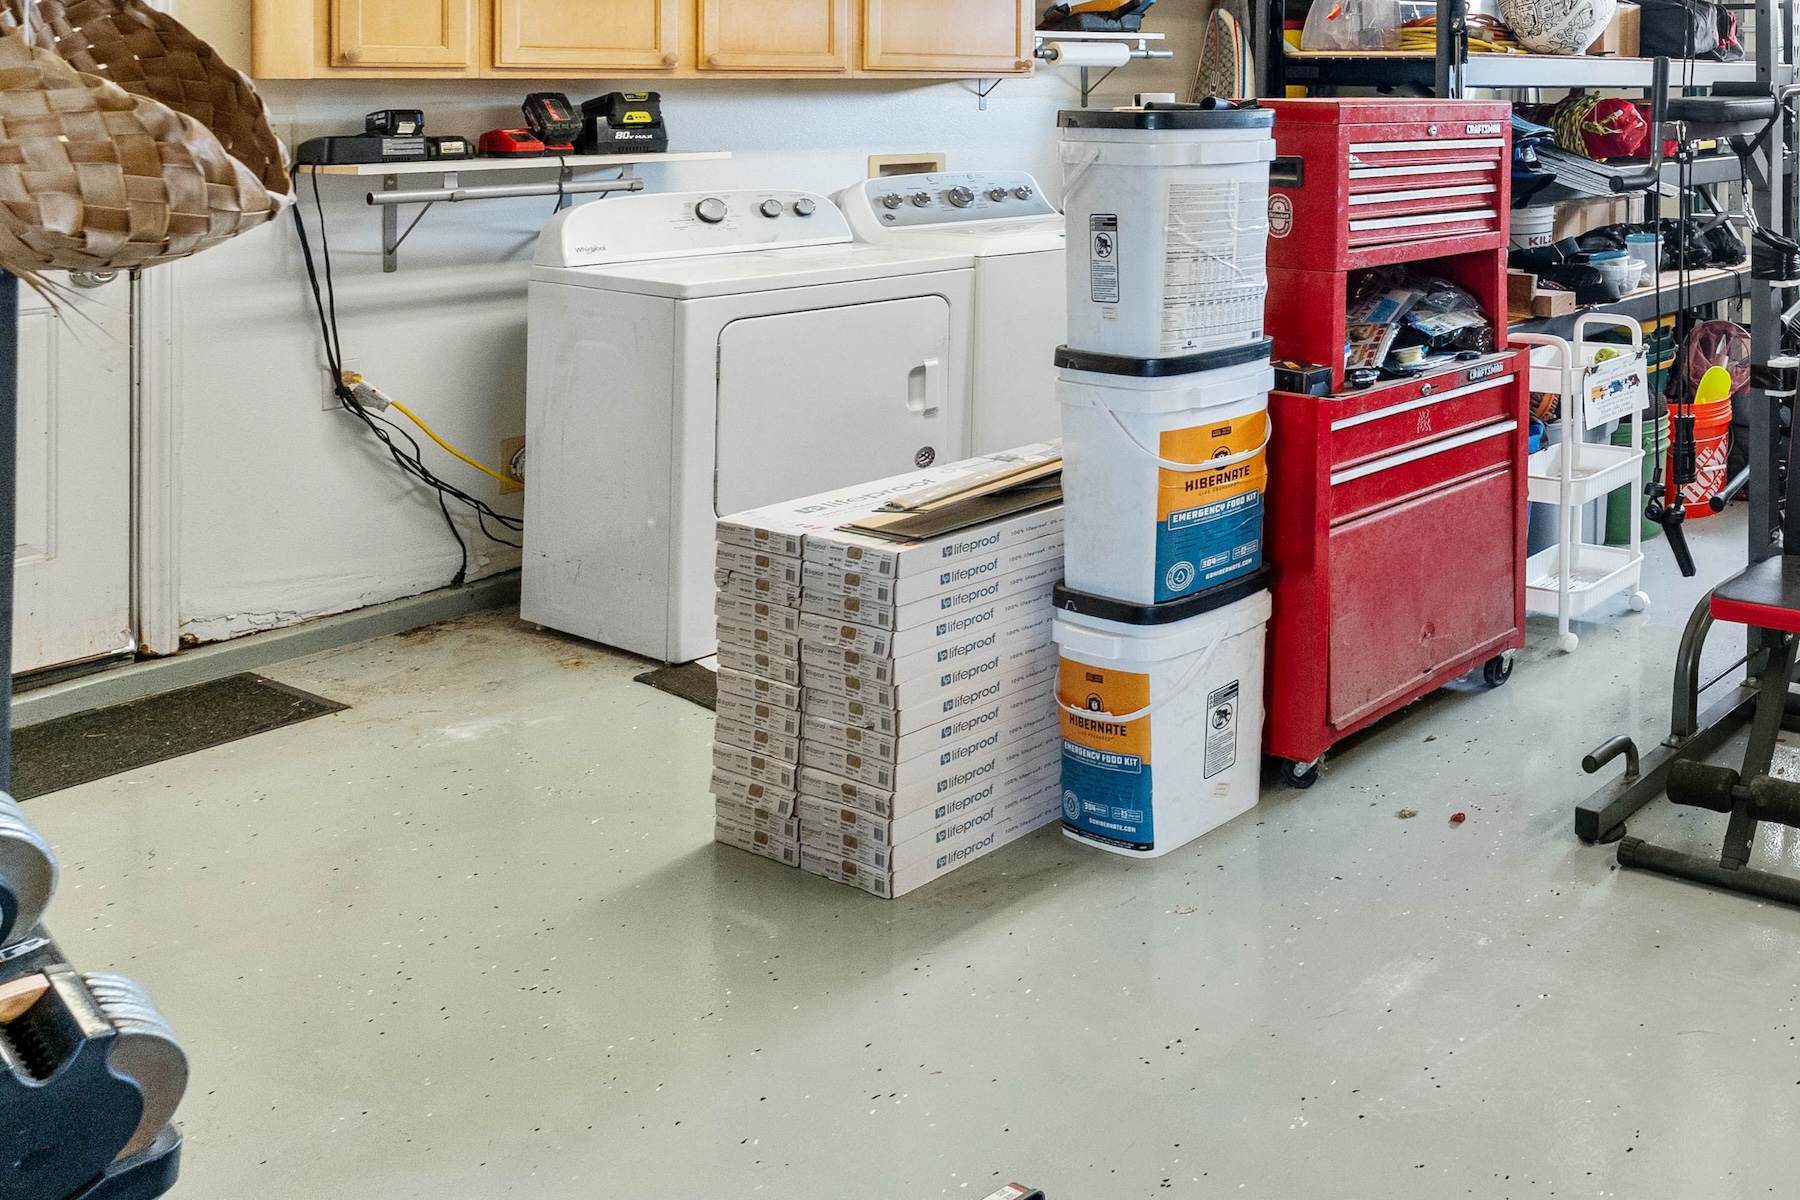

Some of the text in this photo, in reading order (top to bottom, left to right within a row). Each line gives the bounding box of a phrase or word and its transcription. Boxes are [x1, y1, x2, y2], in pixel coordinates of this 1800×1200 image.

[1466, 123, 1501, 135] CRAFTSMAN
[1470, 362, 1504, 380] CRAFTSMAN
[1185, 465, 1250, 492] HIBERNATE
[1172, 504, 1226, 523] EMERGENCY
[1226, 496, 1245, 510] FOOD
[1246, 492, 1257, 503] KIT
[953, 531, 1000, 555] lifeproof
[951, 558, 998, 582] lifeproof
[1201, 557, 1216, 568] 304
[952, 582, 999, 606] lifeproof
[947, 607, 994, 632] lifeproof
[949, 632, 996, 658] lifeproof
[952, 656, 999, 683] lifeproof
[954, 681, 1001, 708] lifeproof
[952, 706, 999, 734] lifeproof
[1069, 712, 1127, 737] HIBERNATE
[951, 732, 998, 761] lifeproof
[1064, 741, 1100, 760] EMERGENCY
[1102, 754, 1122, 765] FOOD
[1124, 757, 1138, 767] KIT
[948, 758, 995, 788] lifeproof
[946, 784, 994, 814] lifeproof
[1084, 802, 1096, 812] 304
[947, 807, 994, 838] lifeproof
[948, 832, 995, 864] lifeproof
